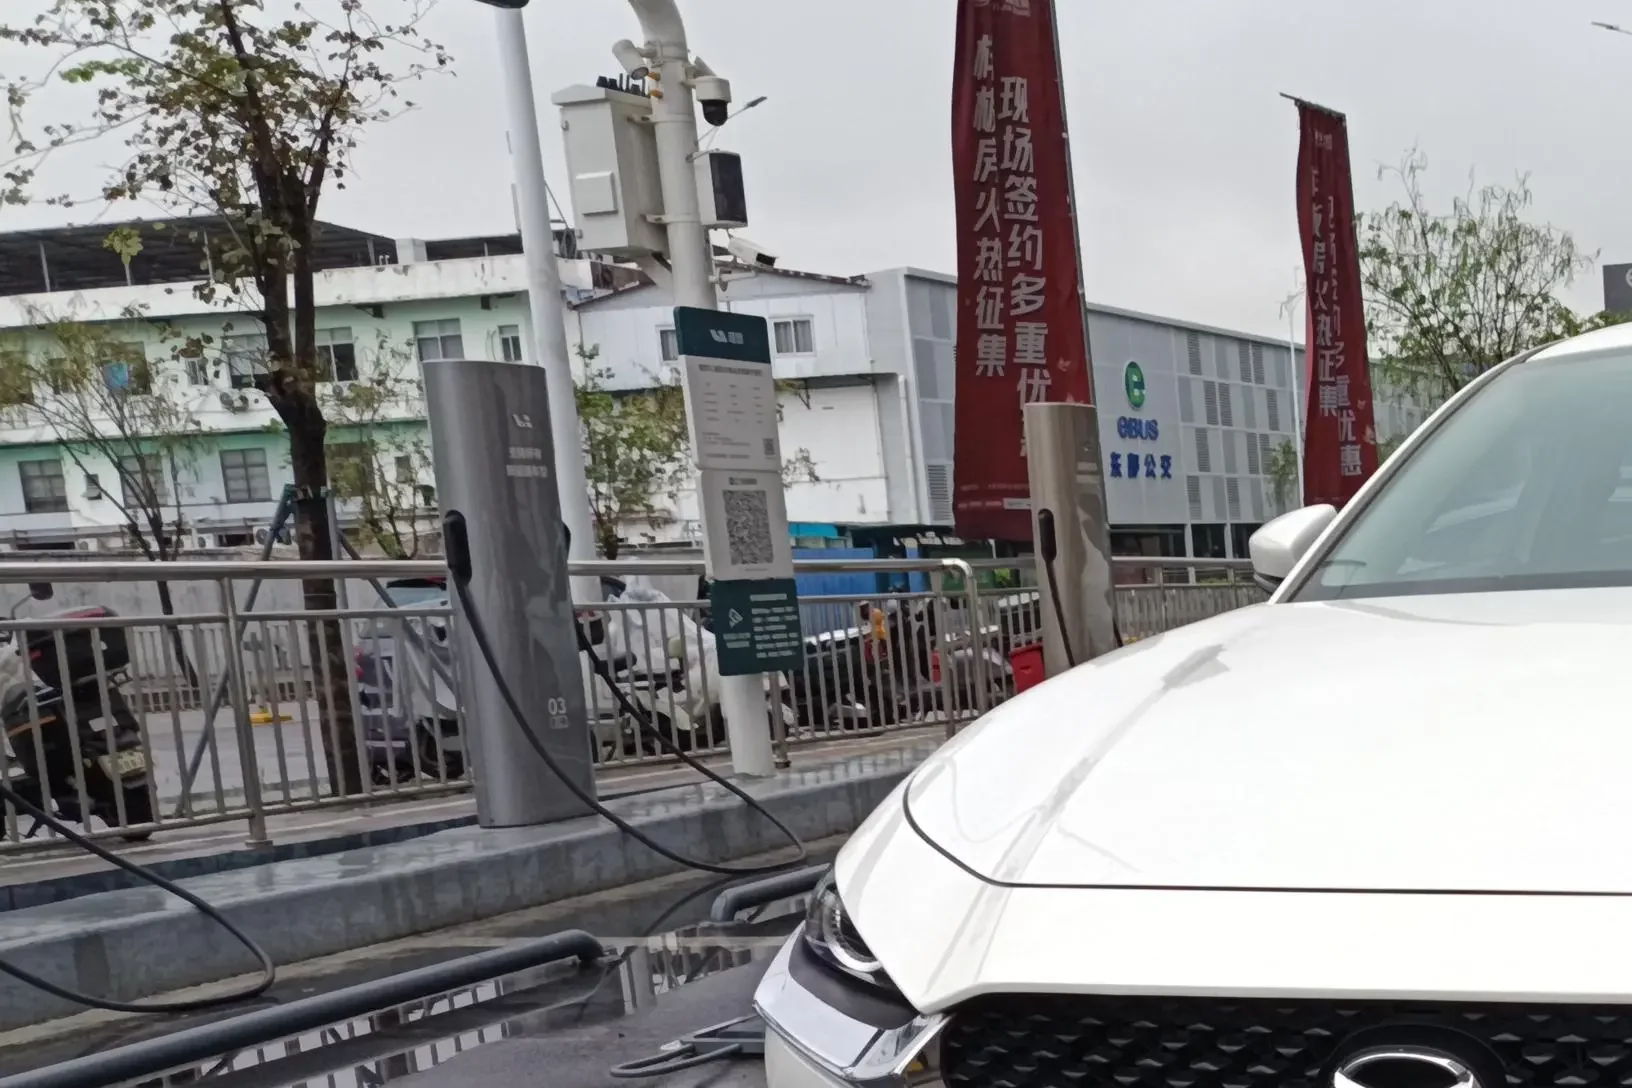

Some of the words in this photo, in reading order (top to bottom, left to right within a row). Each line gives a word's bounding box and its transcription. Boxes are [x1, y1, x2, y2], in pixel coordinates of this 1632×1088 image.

[997, 76, 1052, 458] 现场签约多重优
